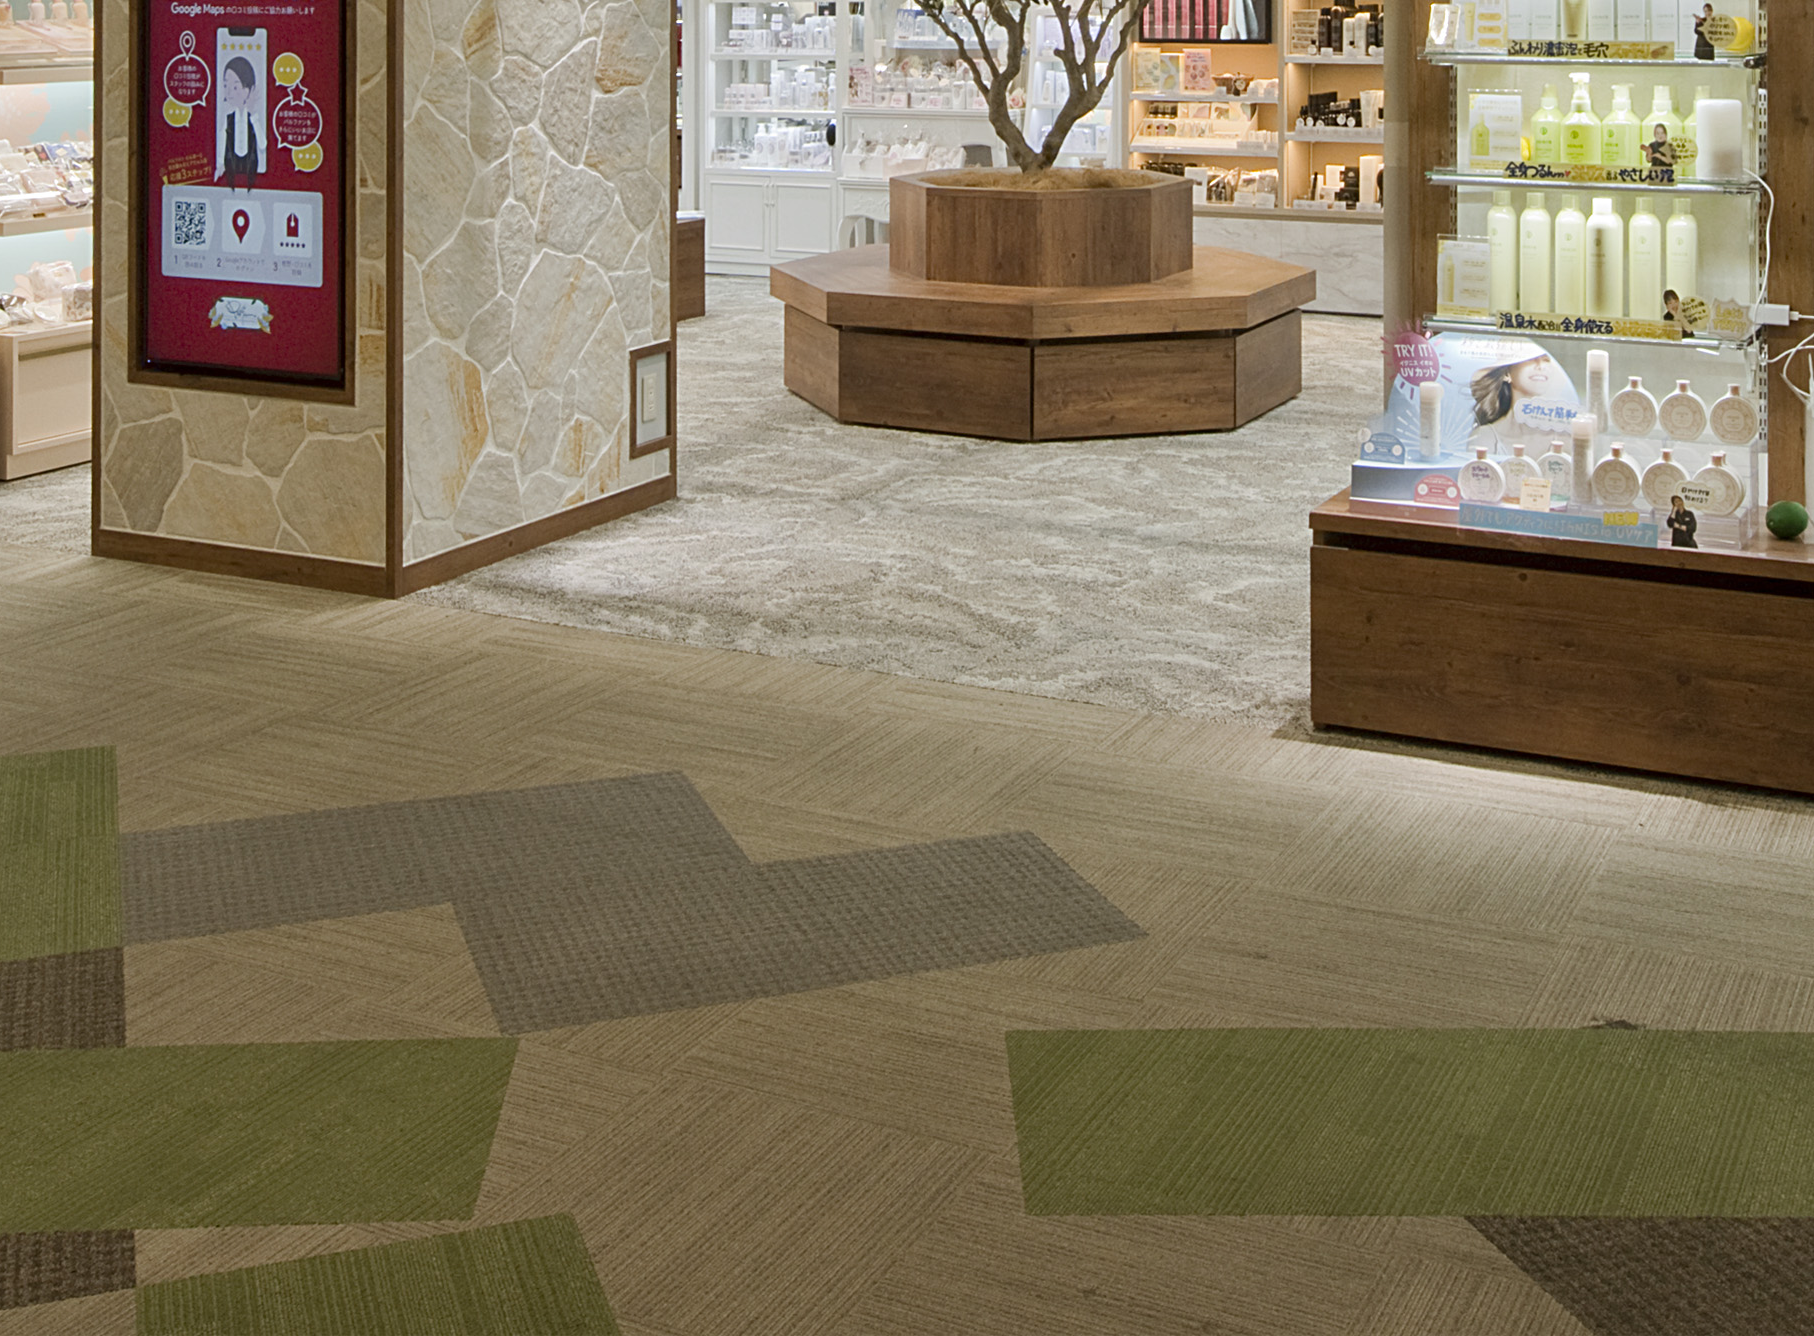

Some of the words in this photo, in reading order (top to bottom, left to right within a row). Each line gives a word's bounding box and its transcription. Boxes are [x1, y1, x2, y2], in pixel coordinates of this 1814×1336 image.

[170, 2, 202, 17] Google
[202, 3, 225, 17] Maps
[1394, 344, 1415, 358] TRY
[1417, 344, 1434, 358] IT!
[1400, 367, 1437, 378] UVカット
[1602, 511, 1639, 527] NEW
